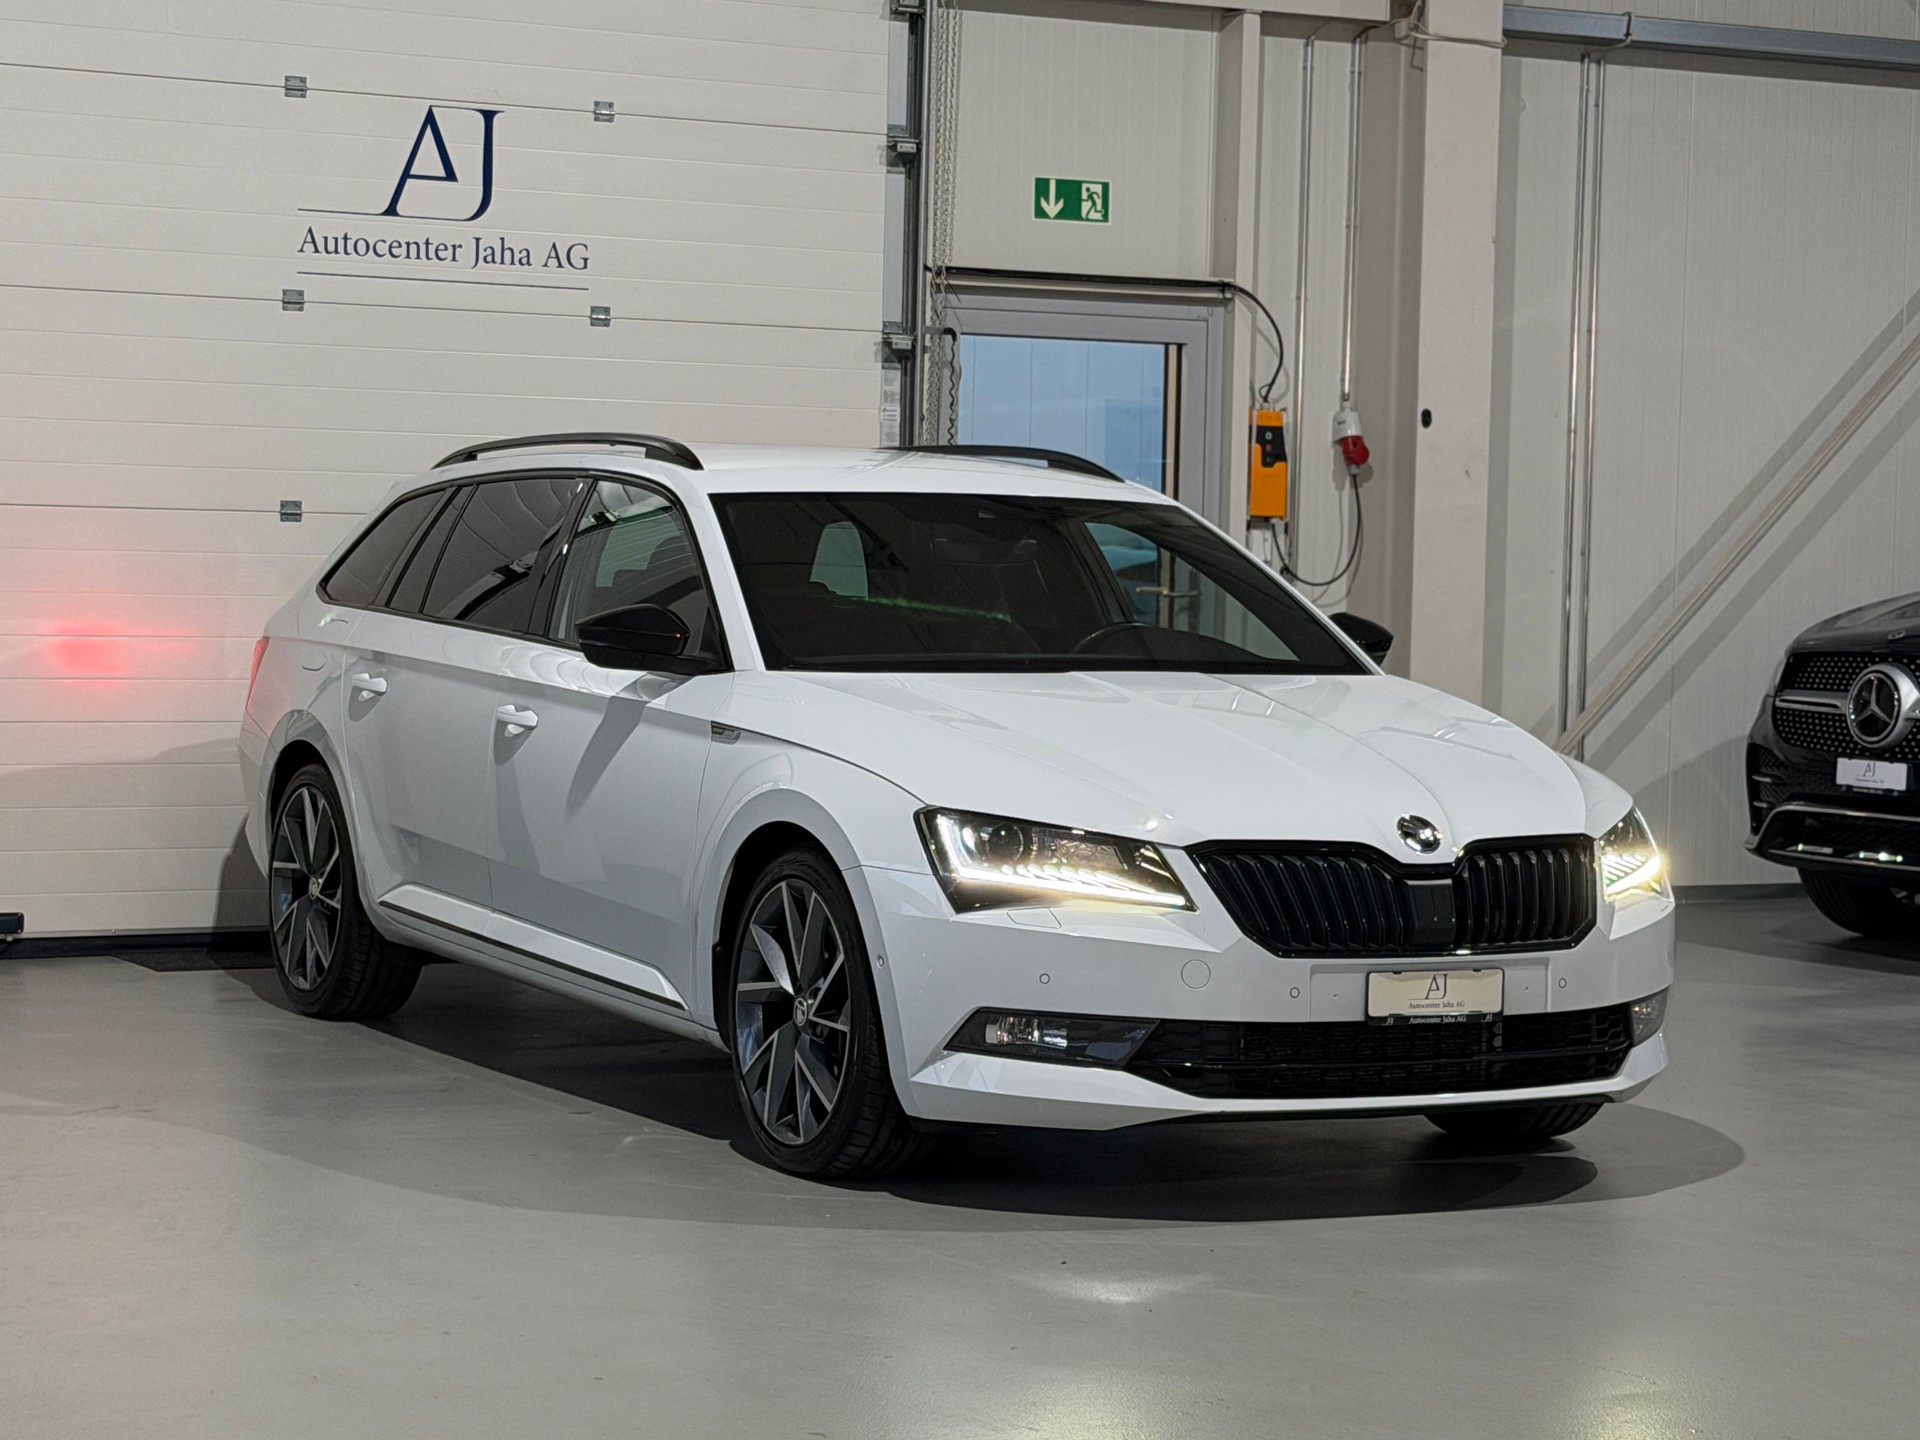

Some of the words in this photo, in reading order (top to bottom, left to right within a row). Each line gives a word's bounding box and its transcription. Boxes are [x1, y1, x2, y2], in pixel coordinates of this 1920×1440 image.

[378, 104, 505, 222] AJ
[296, 225, 463, 263] Autocenter
[471, 236, 533, 270] Jaha
[541, 241, 590, 271] AG
[1424, 973, 1448, 1000] AJ
[1408, 1002, 1441, 1010] Autocenter
[1442, 1001, 1454, 1009] Jaha
[1455, 1000, 1466, 1008] AG
[1408, 1016, 1442, 1024] Autocenter
[1442, 1016, 1456, 1024] Jaha
[1456, 1015, 1467, 1023] AG
